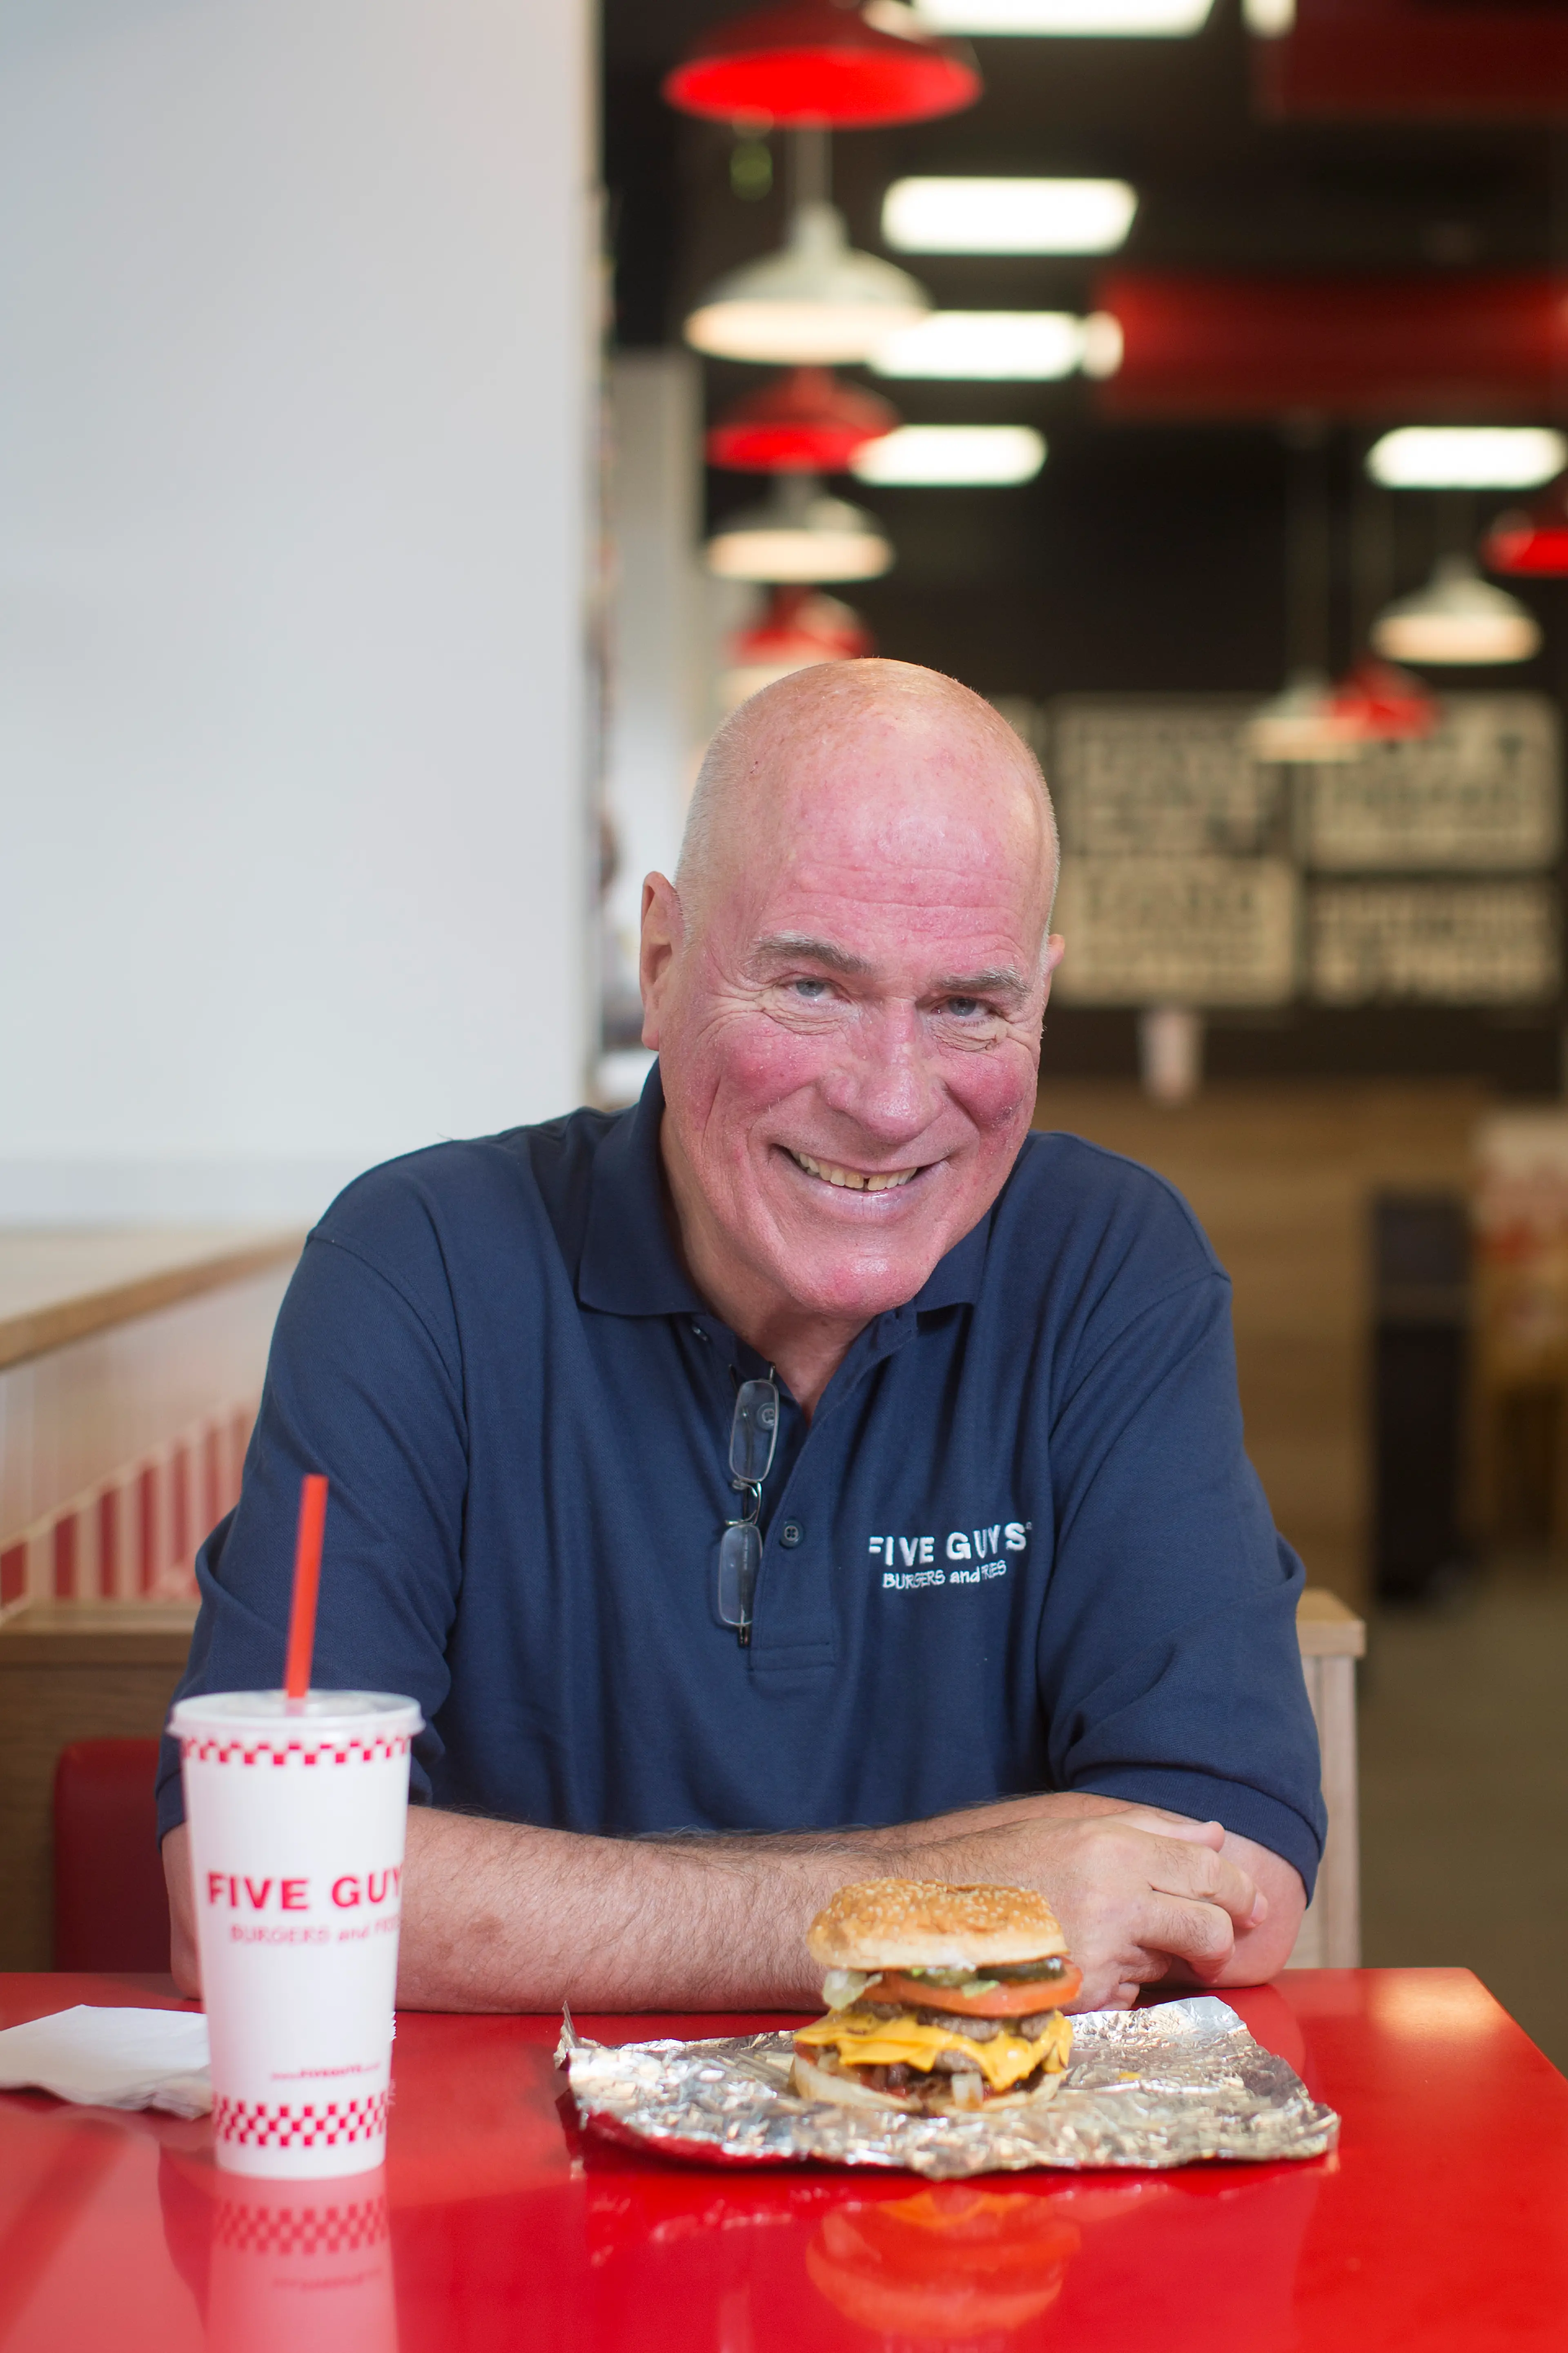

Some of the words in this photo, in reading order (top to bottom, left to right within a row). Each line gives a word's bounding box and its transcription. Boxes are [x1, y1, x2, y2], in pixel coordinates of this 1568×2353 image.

[869, 1536, 935, 1566] FIVE
[882, 1569, 946, 1589] BURGERS
[949, 1566, 980, 1584] and
[208, 1870, 309, 1910] FIVE
[229, 1923, 329, 1944] BURGERS
[338, 1925, 370, 1942] and
